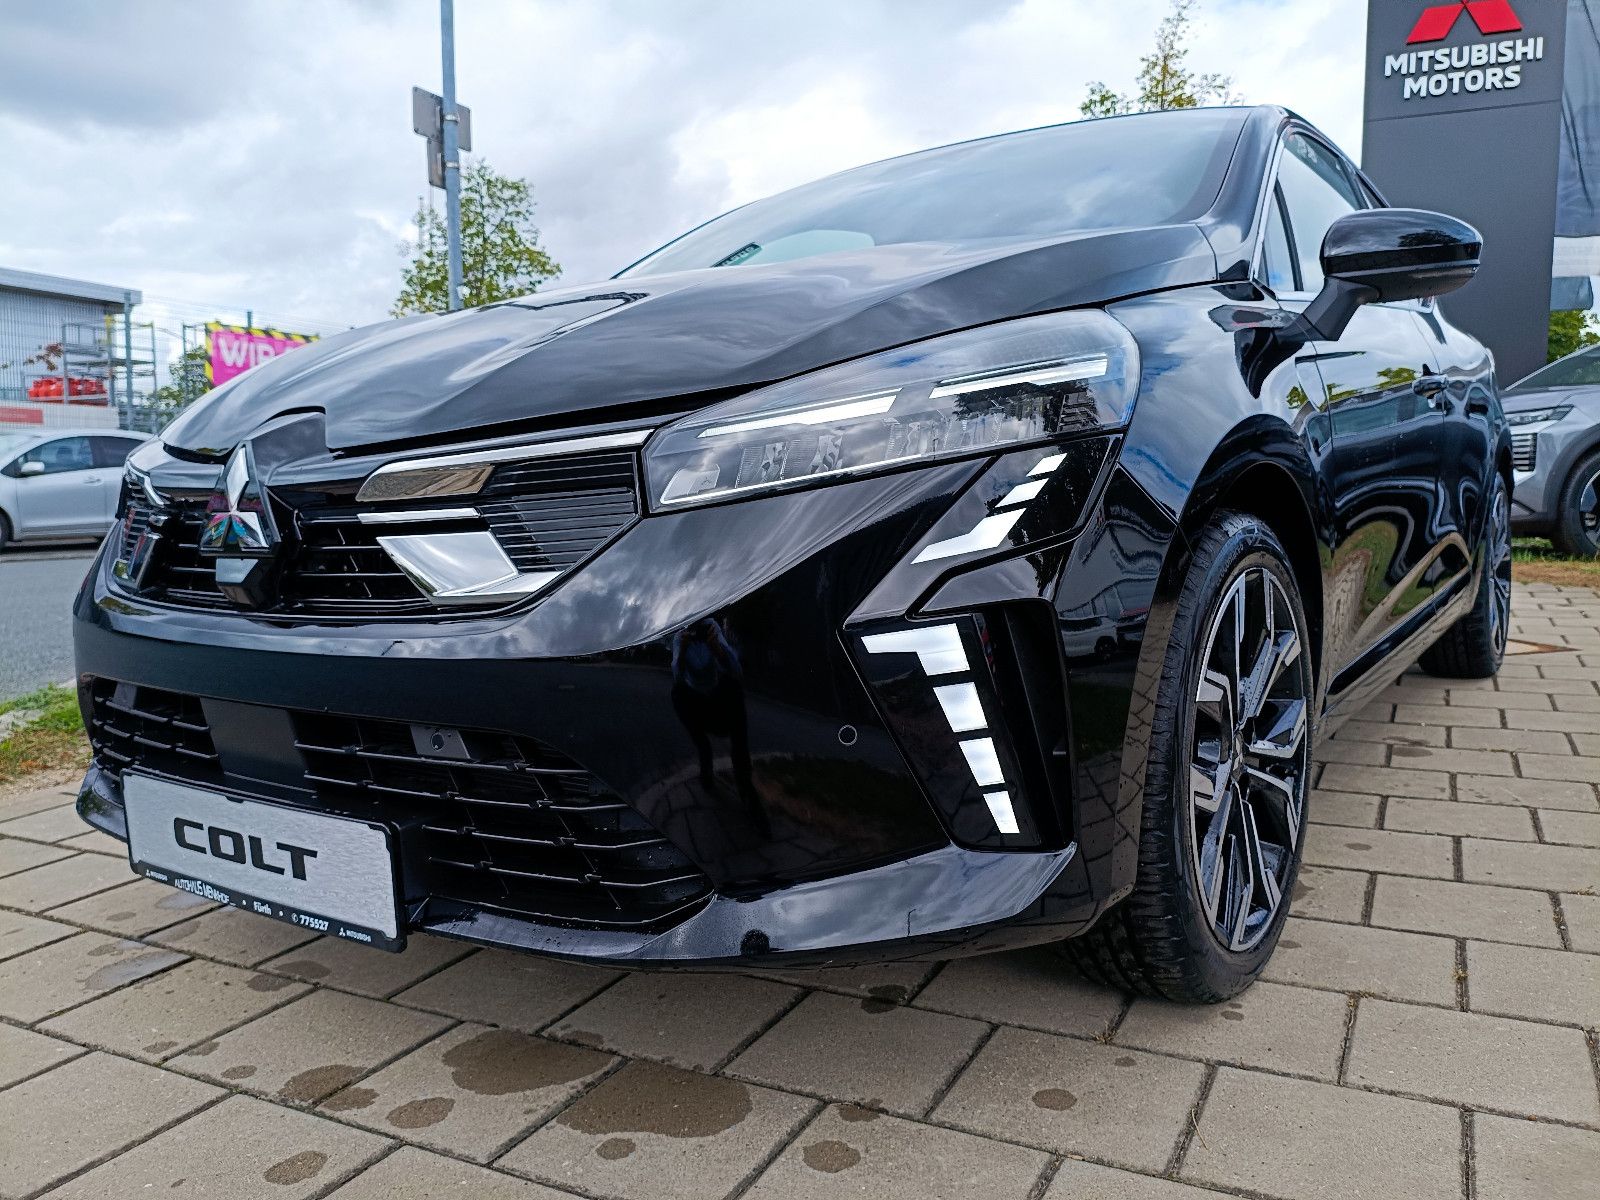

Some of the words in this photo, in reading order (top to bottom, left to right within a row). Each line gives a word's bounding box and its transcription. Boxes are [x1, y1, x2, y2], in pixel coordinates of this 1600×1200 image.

[1384, 36, 1544, 77] MITSUBISHI
[1403, 65, 1521, 99] MOTORS
[173, 817, 318, 881] COLT
[253, 901, 272, 915] Fürth
[299, 915, 329, 931] 775527
